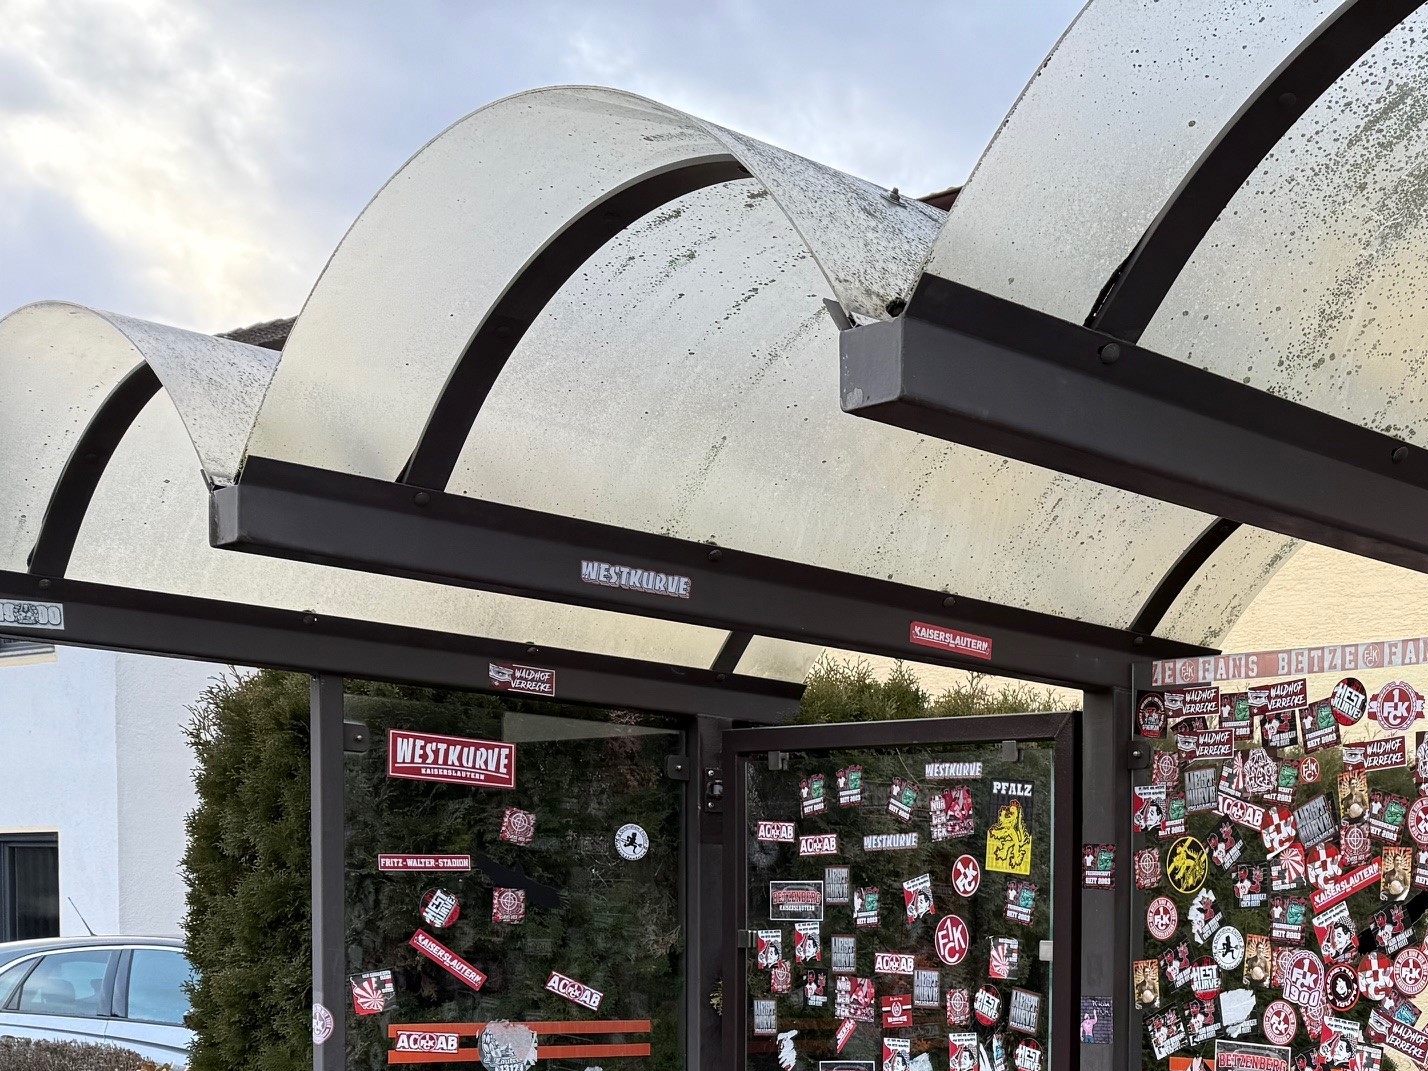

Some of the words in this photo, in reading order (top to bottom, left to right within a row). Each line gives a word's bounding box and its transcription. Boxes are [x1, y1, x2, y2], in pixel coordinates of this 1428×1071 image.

[581, 560, 691, 598] WESTKURVE
[914, 625, 988, 650] KAISERSLAUTERN
[1202, 657, 1259, 683] FANS
[1277, 648, 1355, 675] BETZE
[514, 667, 551, 681] WALDHOF
[511, 678, 553, 694] VERRECKE
[1271, 682, 1303, 696] WALDHOF
[1186, 689, 1216, 703] WALDHOF
[1268, 694, 1305, 710] VERRECKE
[1182, 701, 1217, 714] VERRECKE
[1199, 733, 1230, 745] WALDHOF
[1367, 740, 1400, 754] WALDHOF
[396, 737, 509, 774] WESTKURVE
[1196, 744, 1231, 756] VERRECKE
[1364, 752, 1403, 769] VERRECKE
[421, 768, 485, 780] KAISERSLAUTERN
[925, 762, 982, 779] WESTKURVE
[992, 782, 1033, 797] PFALZ
[863, 833, 918, 850] WESTKURVE
[380, 857, 470, 868] FRITZ-WALTER-STADION
[1314, 865, 1381, 905] KAISERSLAUTERN
[1415, 876, 1428, 886] SEIT
[772, 889, 821, 905] BETZENBERG
[418, 933, 482, 985] KAISERSLAUTERN
[1285, 984, 1322, 1006] 1900
[1392, 1022, 1428, 1046] WALDHOF
[1386, 1033, 1426, 1058] VERRECKE
